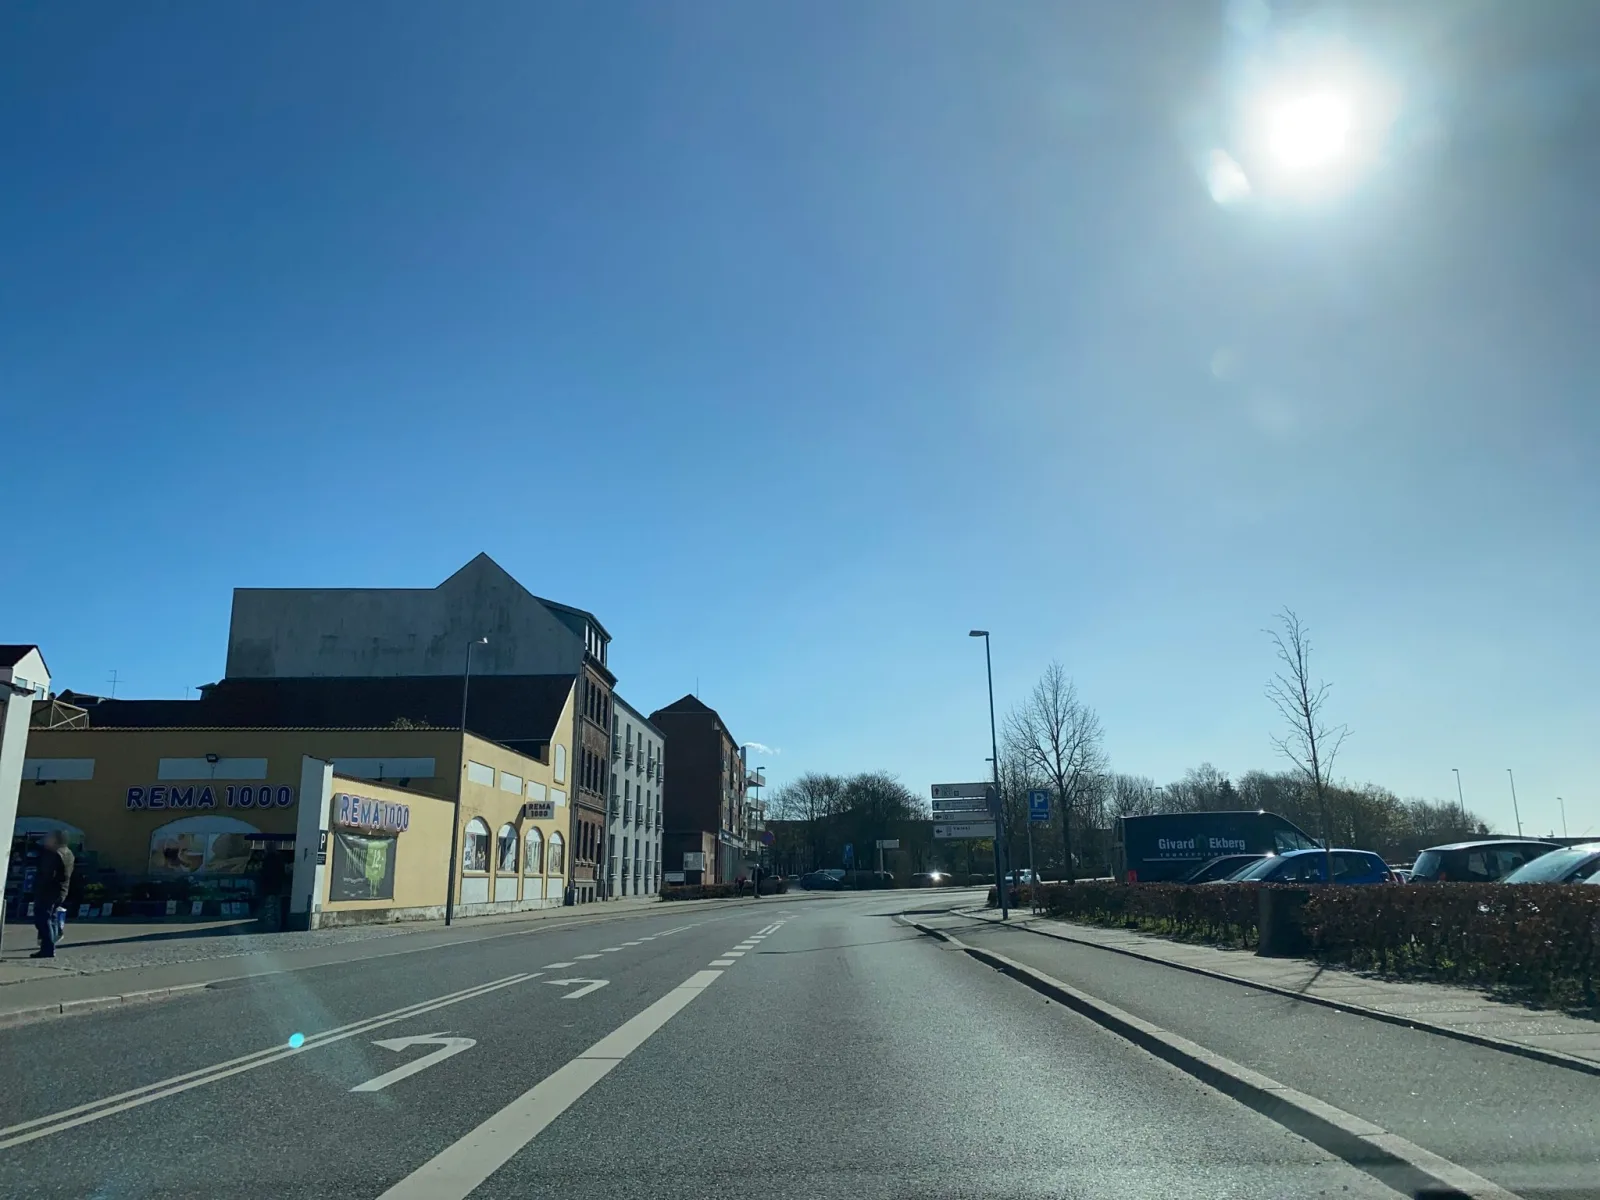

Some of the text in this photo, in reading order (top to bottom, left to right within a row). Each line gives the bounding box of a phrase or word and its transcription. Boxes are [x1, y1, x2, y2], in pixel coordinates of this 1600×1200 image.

[126, 785, 293, 808] REMA 1000
[1034, 793, 1045, 807] P
[341, 795, 409, 831] REMA 1000
[320, 833, 326, 849] P
[1158, 837, 1246, 850] Givard Ekberg
